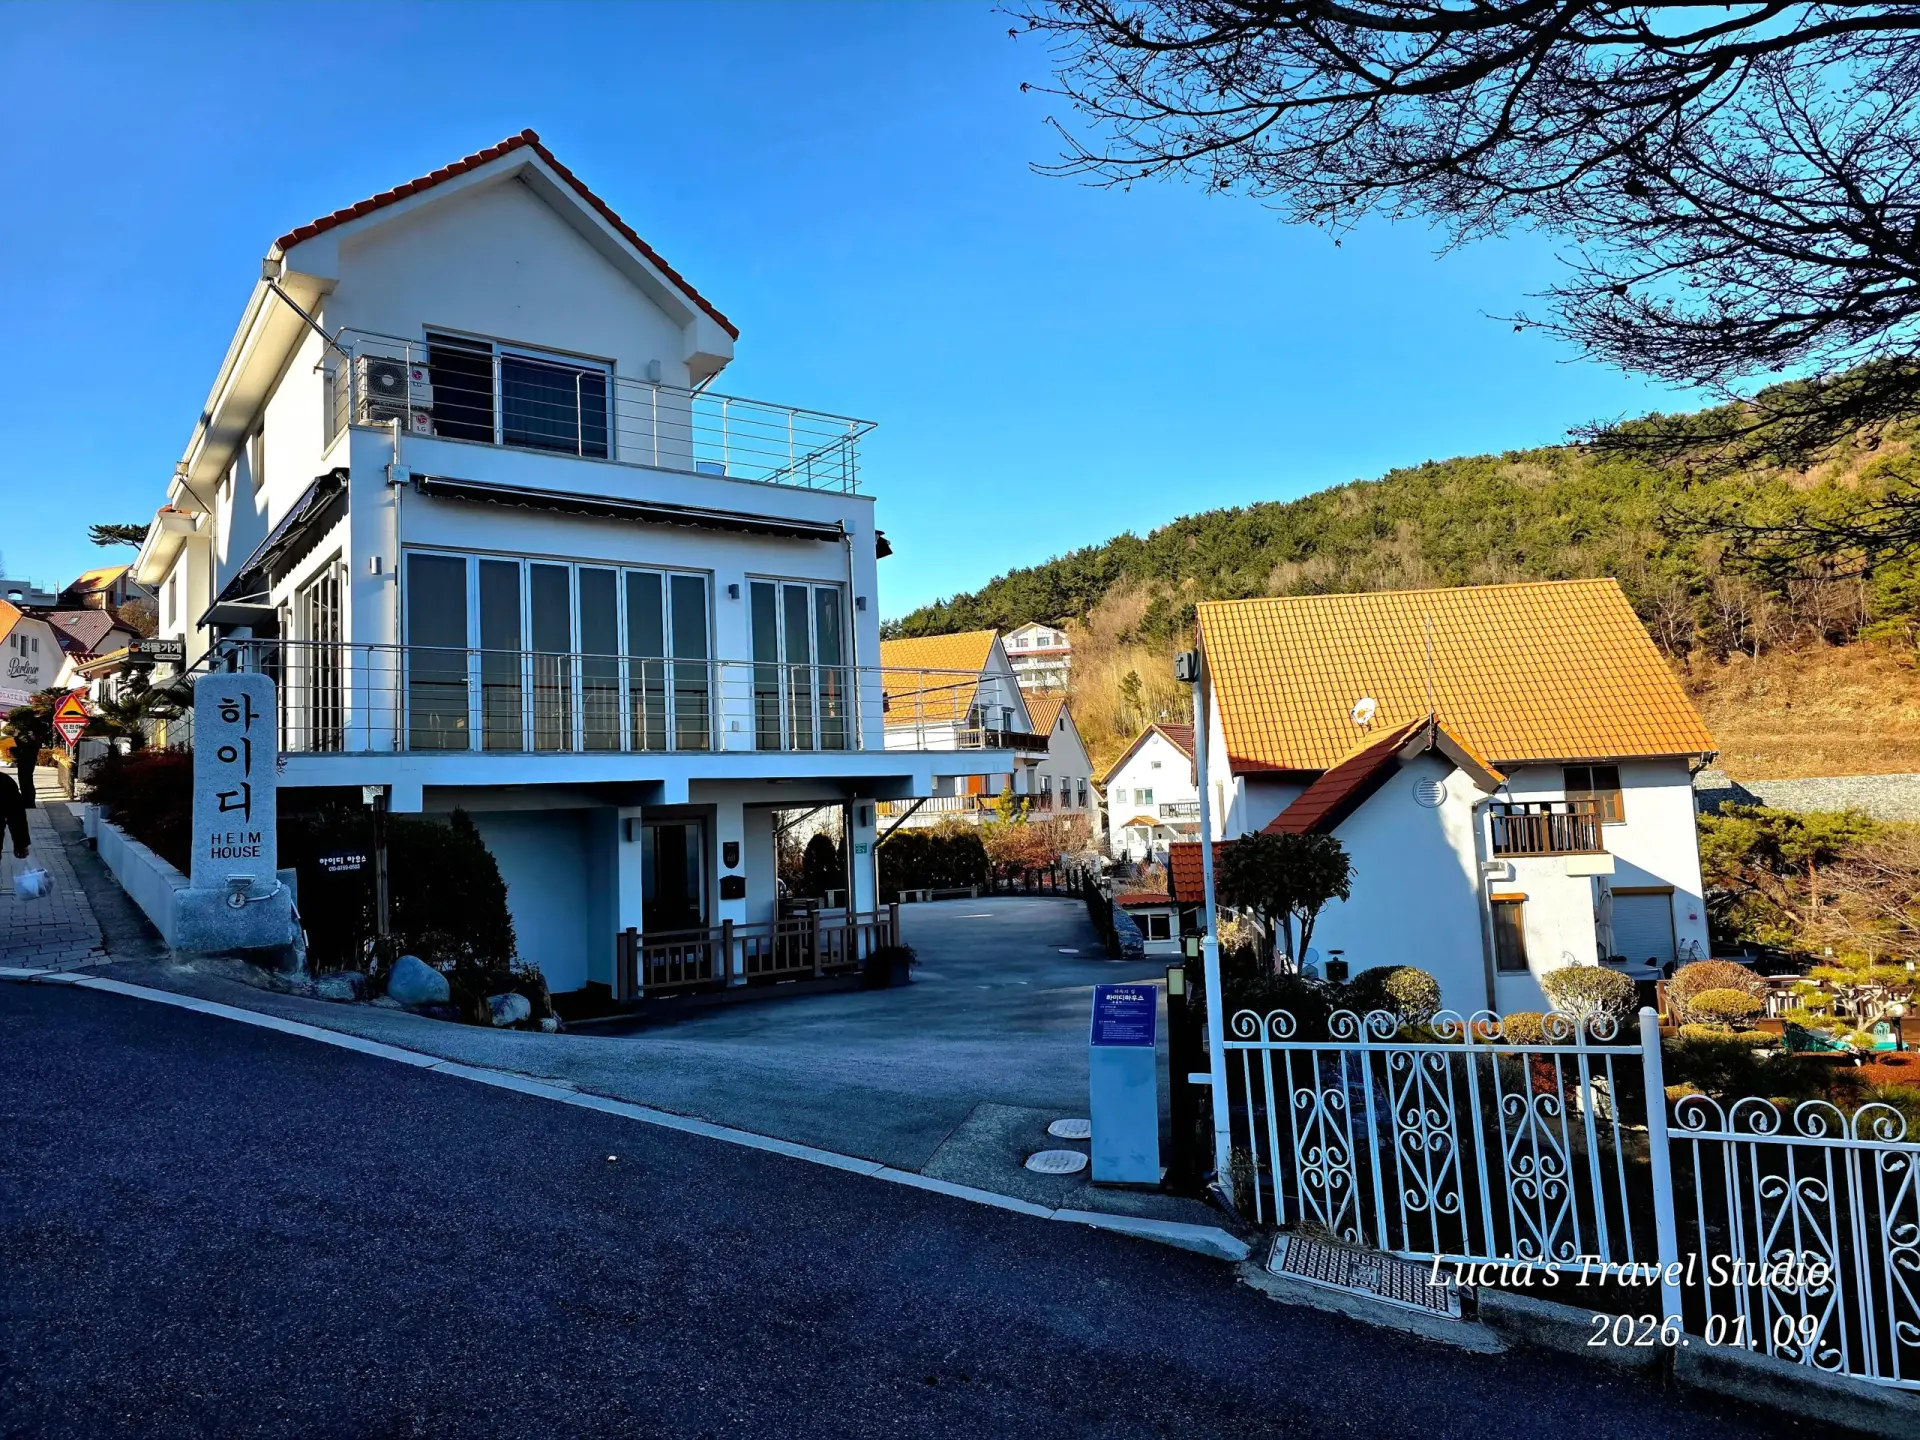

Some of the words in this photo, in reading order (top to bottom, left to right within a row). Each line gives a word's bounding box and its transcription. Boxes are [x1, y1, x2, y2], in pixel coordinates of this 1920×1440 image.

[141, 642, 182, 653] 선물가게
[7, 657, 39, 677] Berliner
[216, 693, 260, 824] 하이디
[211, 832, 261, 844] HEIM
[211, 845, 261, 859] HOUSE
